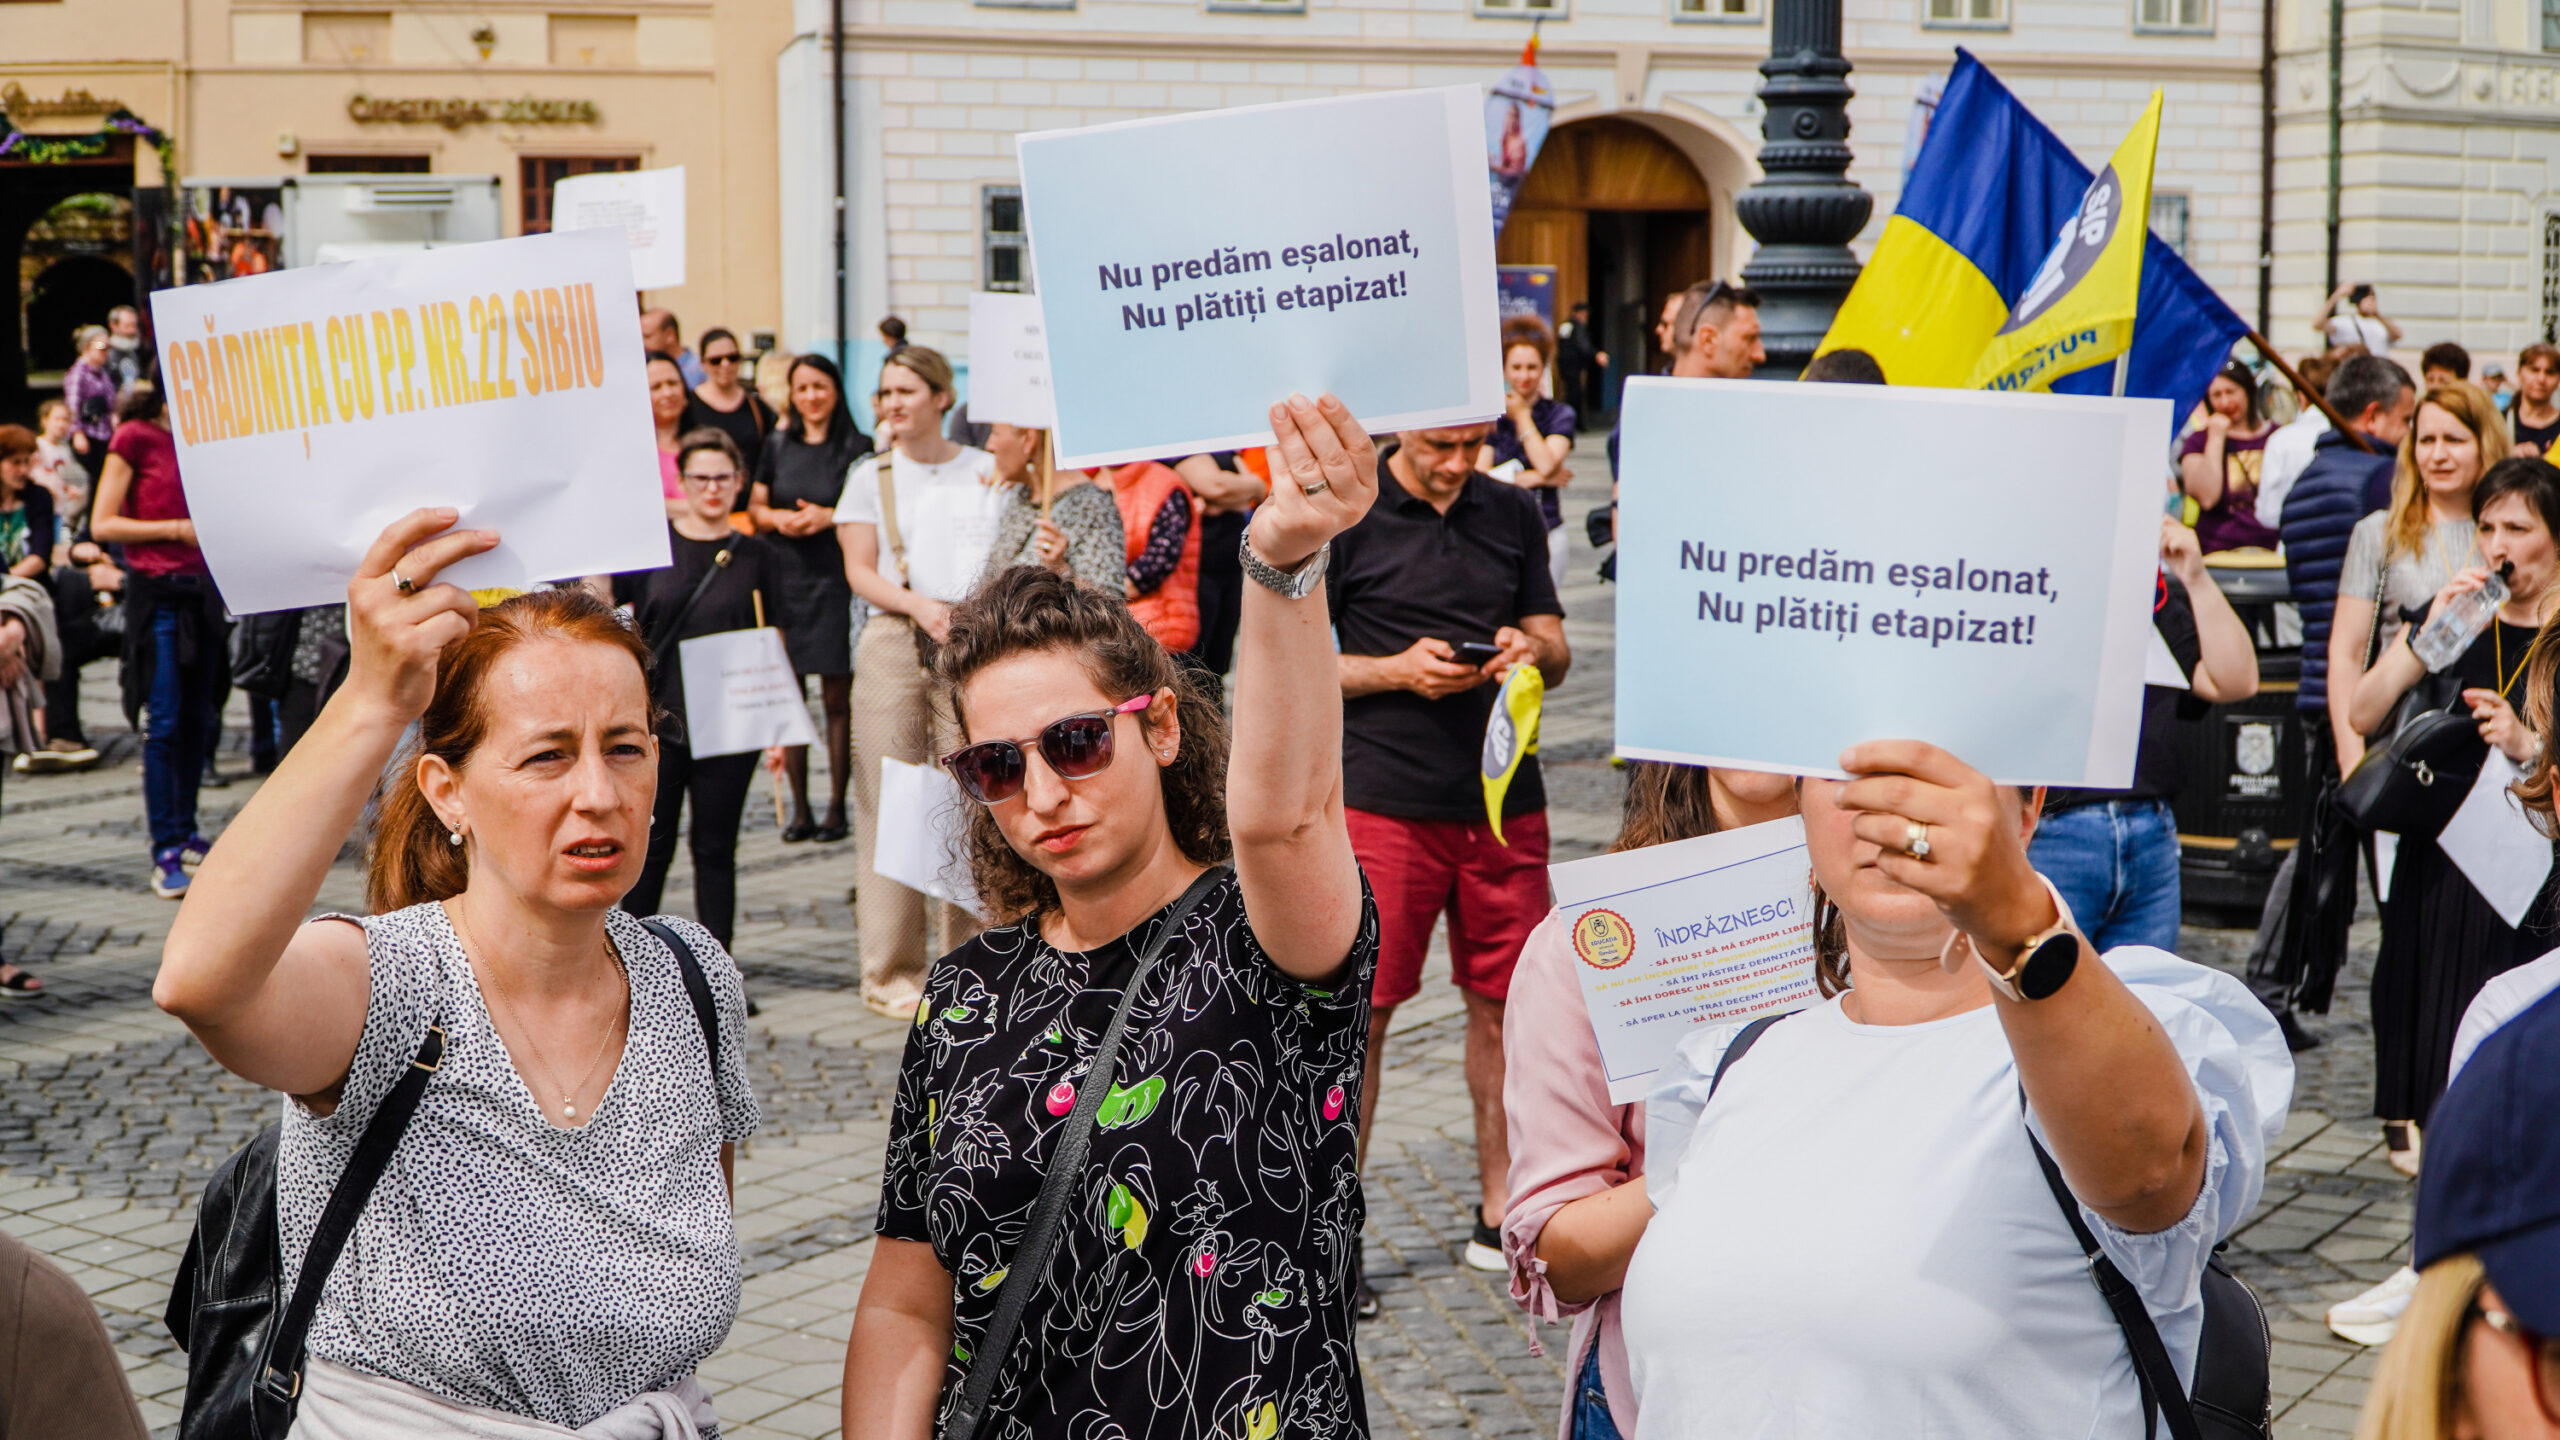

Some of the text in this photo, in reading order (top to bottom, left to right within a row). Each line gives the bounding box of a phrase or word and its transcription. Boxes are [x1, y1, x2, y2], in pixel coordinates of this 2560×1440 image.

[1098, 229, 1419, 291] Nu predăm eșalonat,
[1122, 270, 1408, 331] Nu plătiți etapizat!
[169, 314, 331, 461] GRĂDINIȚA
[326, 314, 375, 423] CU
[371, 307, 426, 415] P.P.
[513, 282, 604, 396] SIBIU
[1680, 540, 2058, 603] Nu predăm eșalonat,
[1698, 590, 2036, 648] Nu plătiți etapizat!
[1654, 897, 1795, 948] ÎNDRĂZNESC!
[1671, 954, 1689, 964] FIU
[1705, 946, 1718, 956] SĂ
[1721, 940, 1736, 951] MĂ
[1739, 931, 1779, 947] EXPRIM
[1619, 998, 1632, 1007] SĂ
[1635, 994, 1652, 1004] ÎMI
[1654, 986, 1693, 1000] DORESC
[1695, 982, 1710, 991] UN
[1712, 974, 1750, 987] SISTEM
[1702, 963, 1747, 979] PĂSTREZ
[1625, 1018, 1639, 1027] SĂ
[1641, 1013, 1666, 1024] SPER
[1668, 1009, 1680, 1017] LA
[1682, 1007, 1697, 1015] UN
[1699, 1001, 1723, 1011] TRAI
[1726, 991, 1764, 1006] DECENT
[1768, 980, 1808, 996] PENTRU
[1693, 1014, 1706, 1024] SĂ
[1708, 1011, 1726, 1022] ÎMI
[1728, 1007, 1748, 1017] CER
[1750, 988, 1818, 1012] DREPTURILE!
